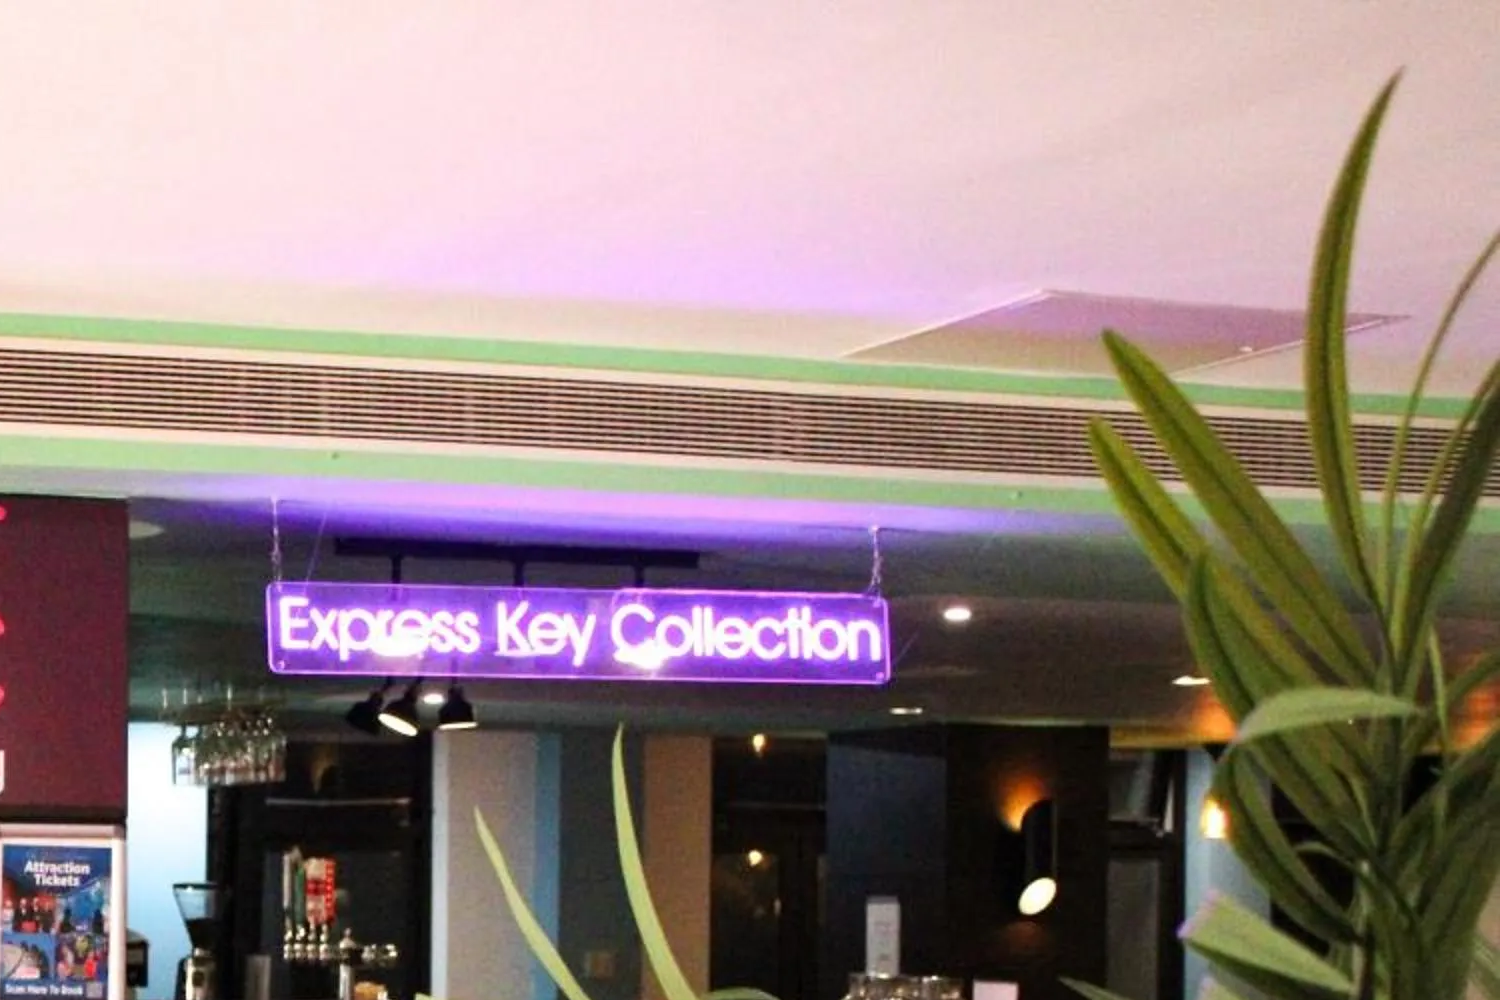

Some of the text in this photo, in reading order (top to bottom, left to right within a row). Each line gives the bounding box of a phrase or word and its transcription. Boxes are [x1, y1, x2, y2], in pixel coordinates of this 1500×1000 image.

[278, 595, 882, 669] Express Key Collection
[24, 861, 90, 876] Attraction
[35, 874, 80, 887] Tickets
